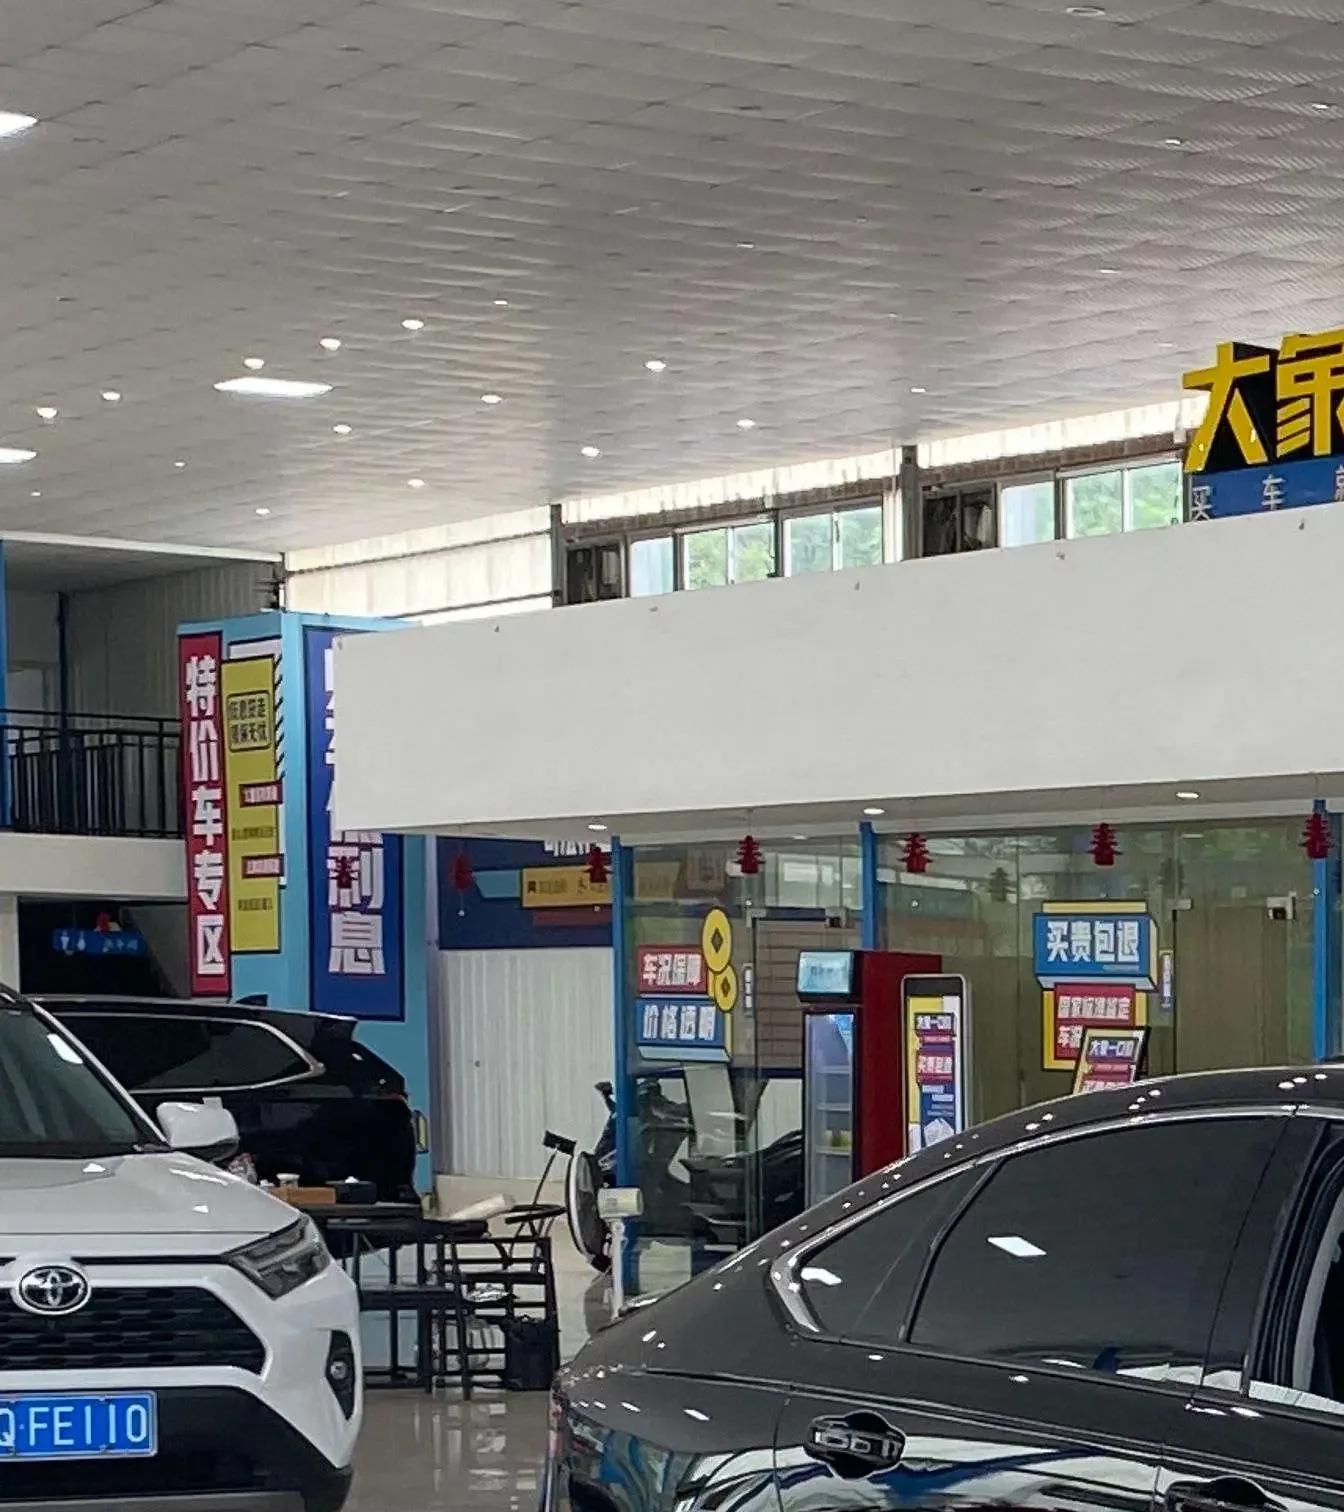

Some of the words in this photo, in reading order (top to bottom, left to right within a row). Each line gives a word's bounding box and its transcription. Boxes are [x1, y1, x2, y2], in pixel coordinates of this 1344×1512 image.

[184, 654, 226, 975] 特价车专区
[1047, 920, 1140, 963] 买贵包退
